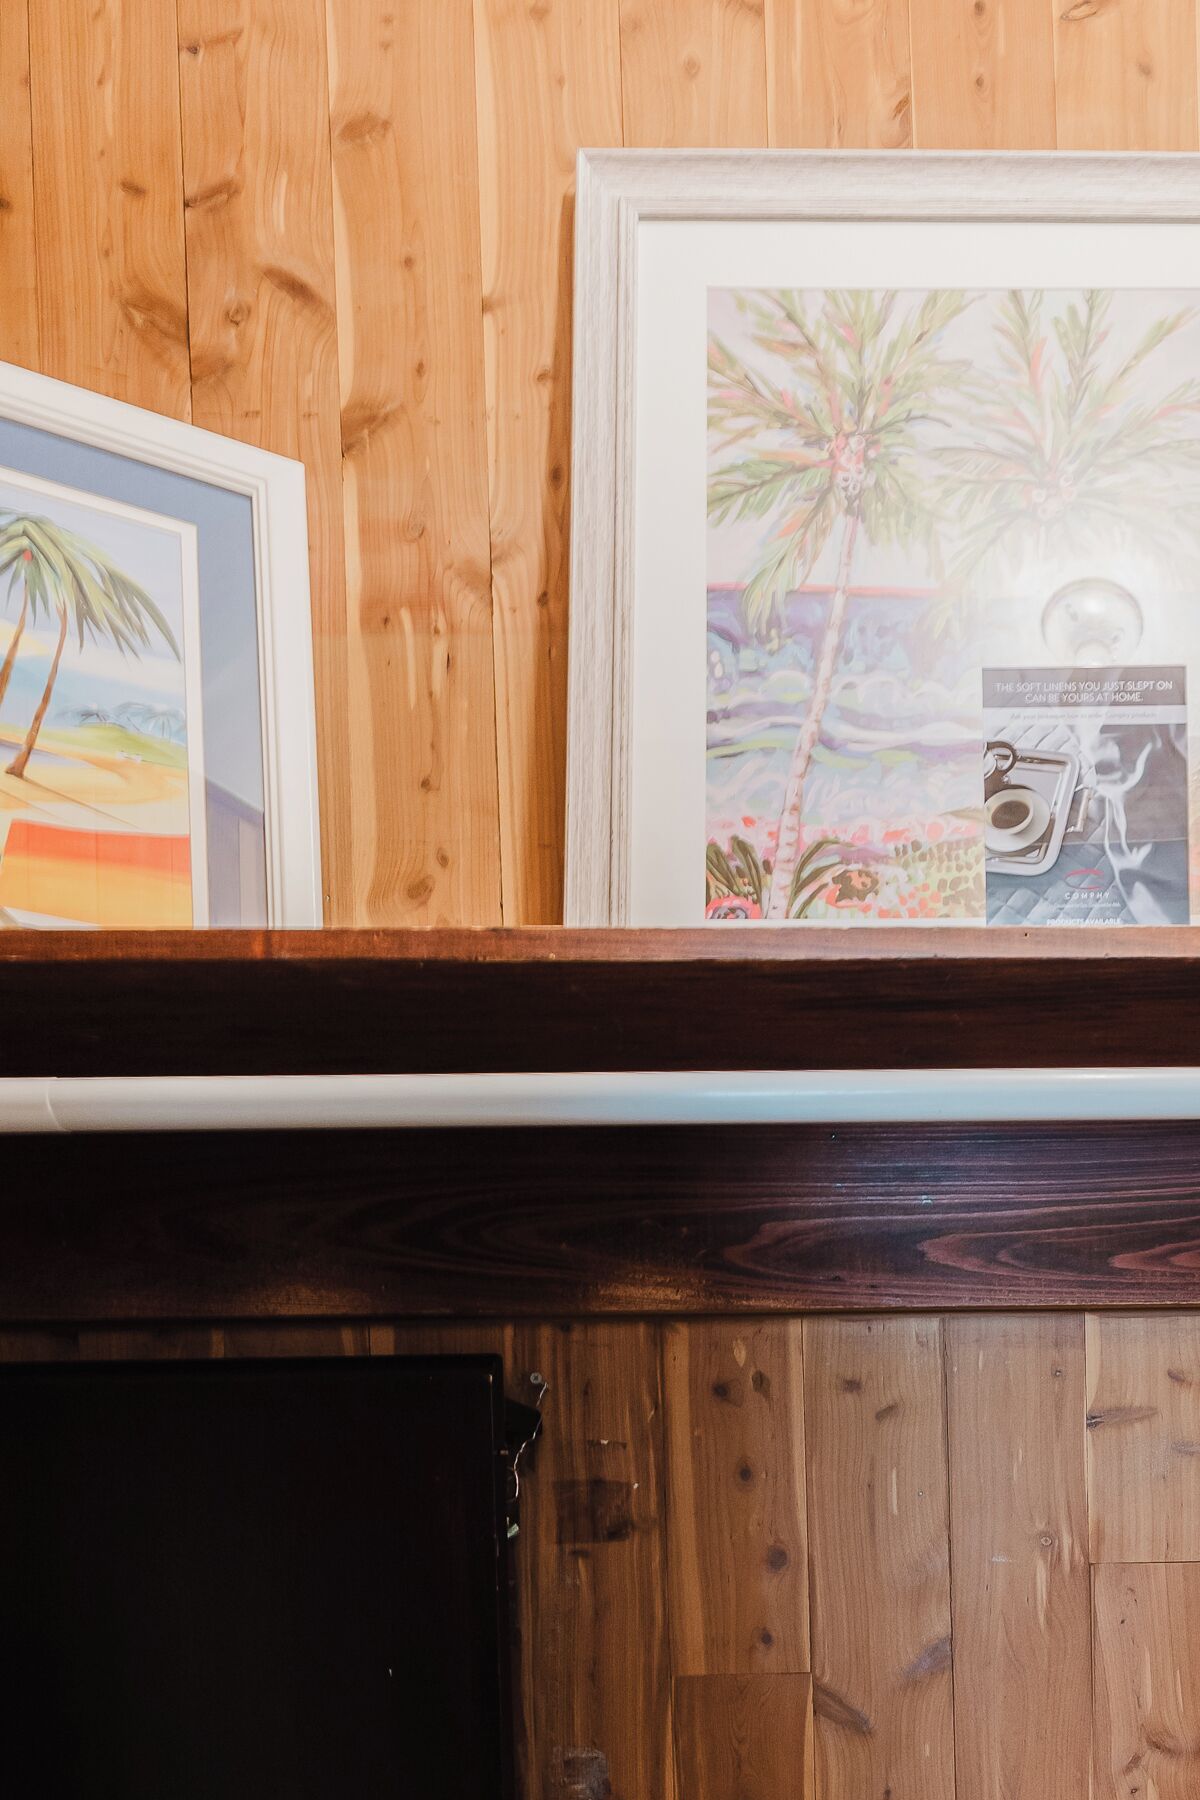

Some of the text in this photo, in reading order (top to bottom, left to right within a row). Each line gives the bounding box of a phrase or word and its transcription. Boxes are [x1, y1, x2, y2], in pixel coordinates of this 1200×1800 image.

[994, 680, 1173, 692] THE SOFT LINENS YOU JUST SLEPT ON
[1025, 692, 1144, 703] CAN BE YOURS AT HOME.
[1064, 891, 1110, 900] COMPHY
[1046, 918, 1121, 926] PRODUCTS AVAILABLE
